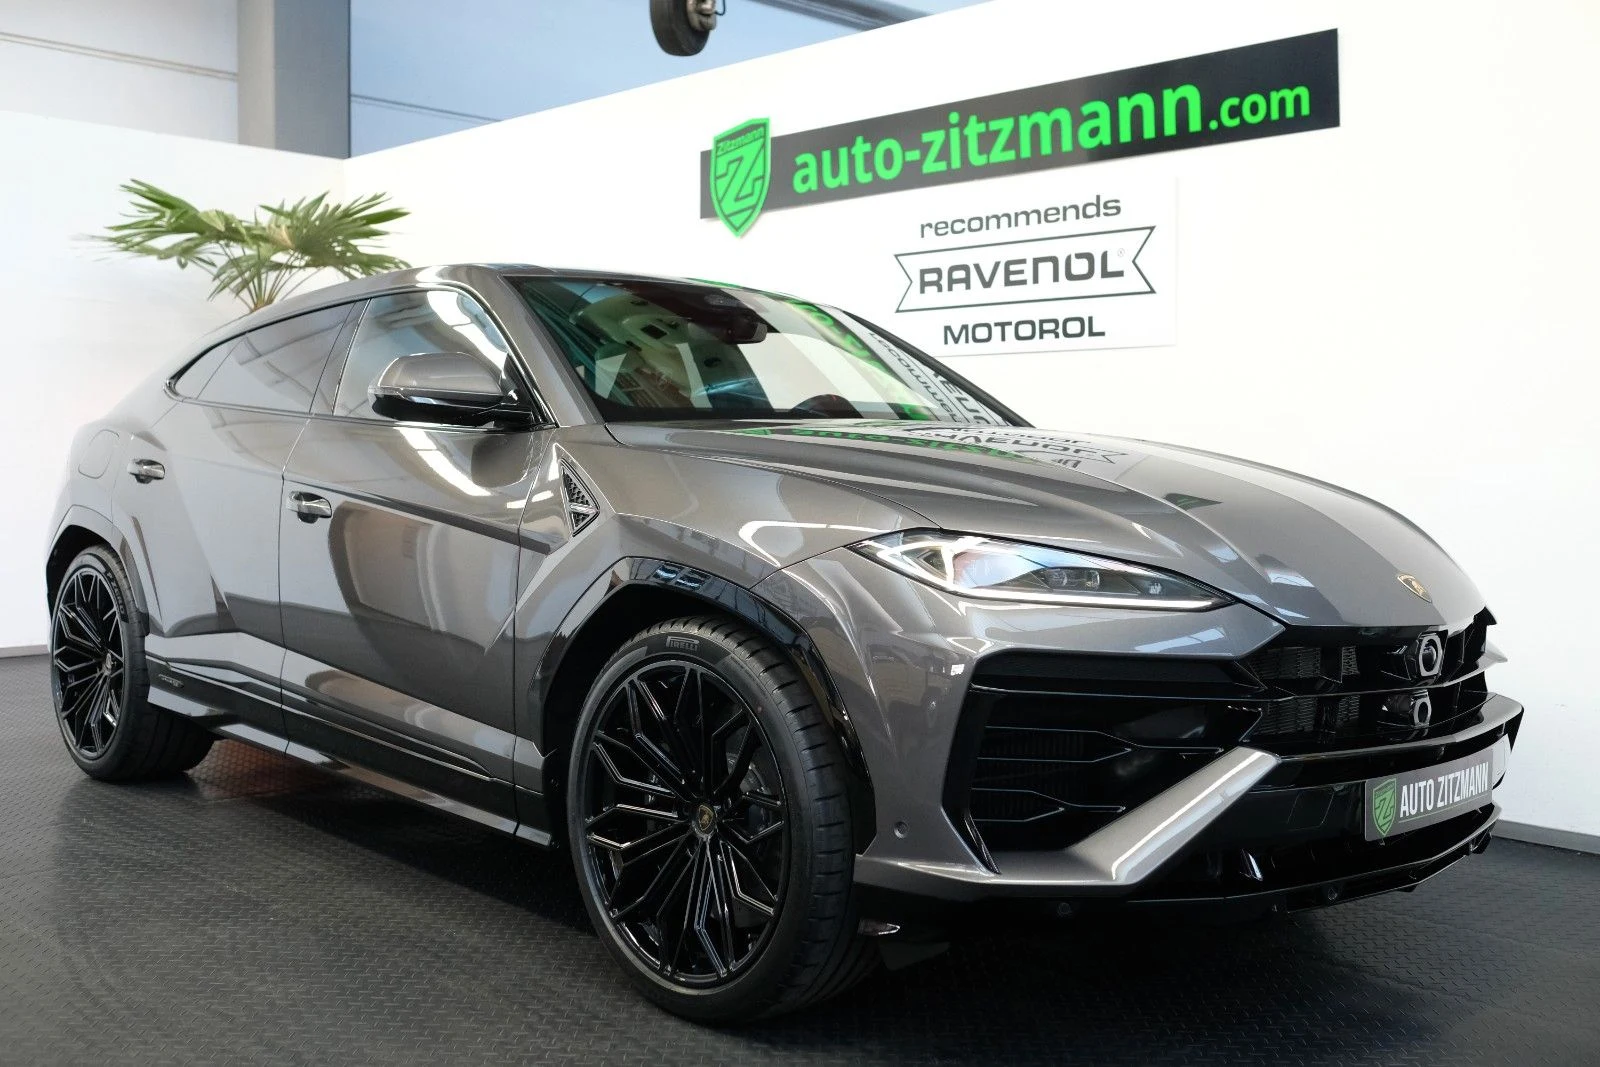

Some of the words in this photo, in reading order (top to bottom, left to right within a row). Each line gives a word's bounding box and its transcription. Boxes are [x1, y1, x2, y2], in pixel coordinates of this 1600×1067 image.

[791, 82, 1311, 194] auto-zitzmann.com
[919, 194, 1122, 239] recommends
[918, 250, 1125, 295] RAVENOL
[943, 315, 1106, 346] MOTOROL
[665, 635, 700, 652] PIRELLI
[1400, 778, 1435, 818] AUTO
[1436, 761, 1489, 808] ZITZMANN
